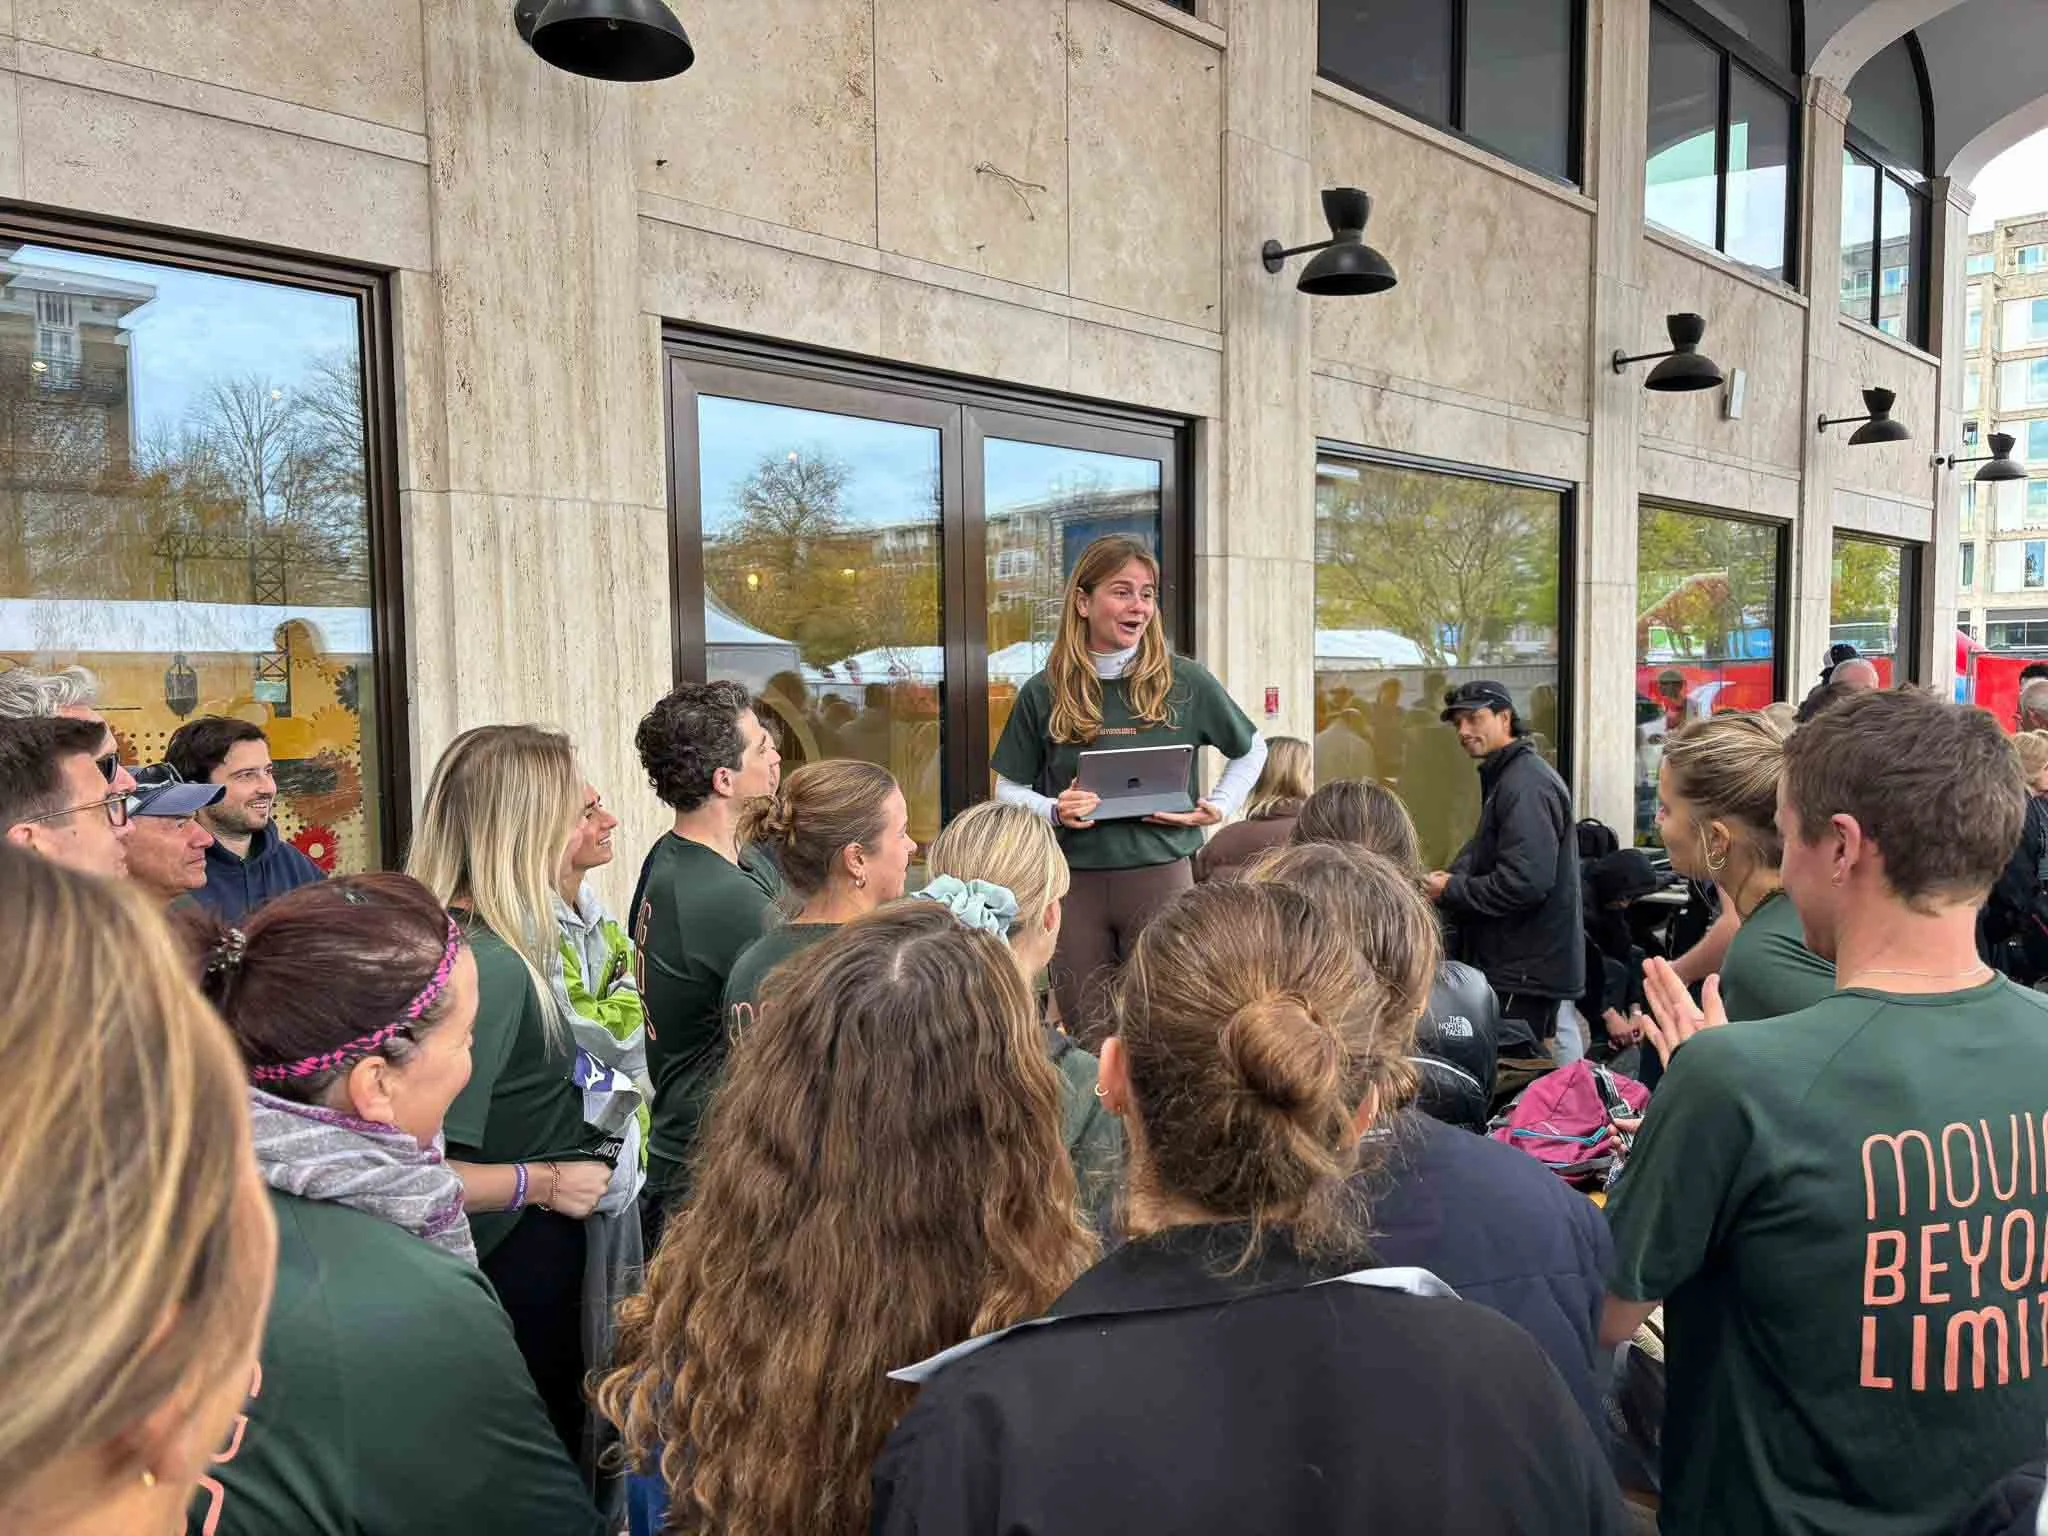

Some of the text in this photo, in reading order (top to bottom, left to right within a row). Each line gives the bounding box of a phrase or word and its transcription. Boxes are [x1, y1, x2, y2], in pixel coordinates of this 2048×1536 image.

[1438, 1022, 1463, 1030] NORTH
[1861, 1110, 2048, 1221] MOVI
[1863, 1208, 2048, 1306] BEYO
